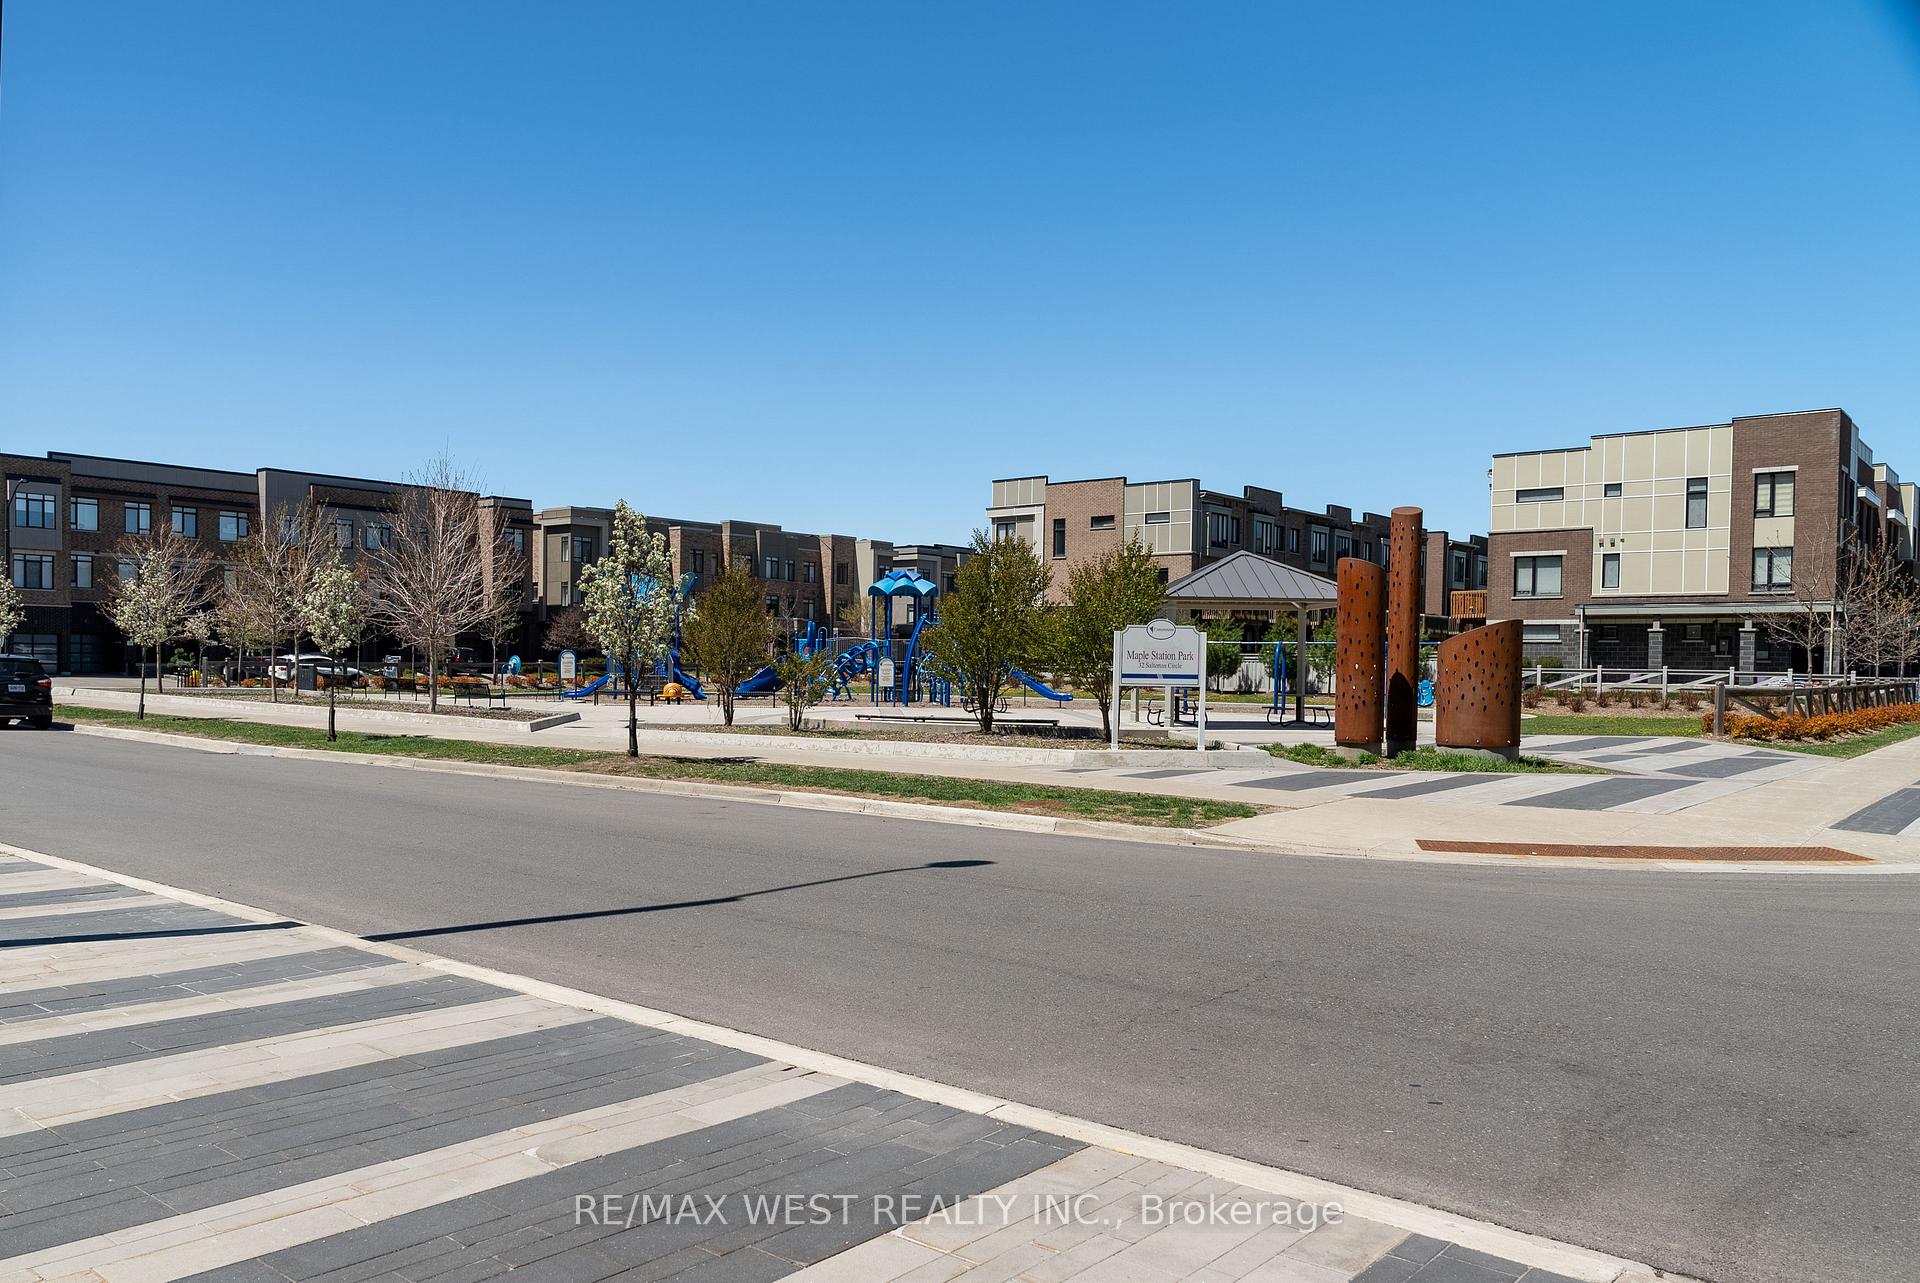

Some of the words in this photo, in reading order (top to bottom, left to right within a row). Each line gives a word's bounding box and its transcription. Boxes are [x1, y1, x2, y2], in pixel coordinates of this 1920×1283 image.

[1127, 650, 1149, 662] Maple
[1151, 650, 1176, 661] Station
[1178, 651, 1194, 661] Park
